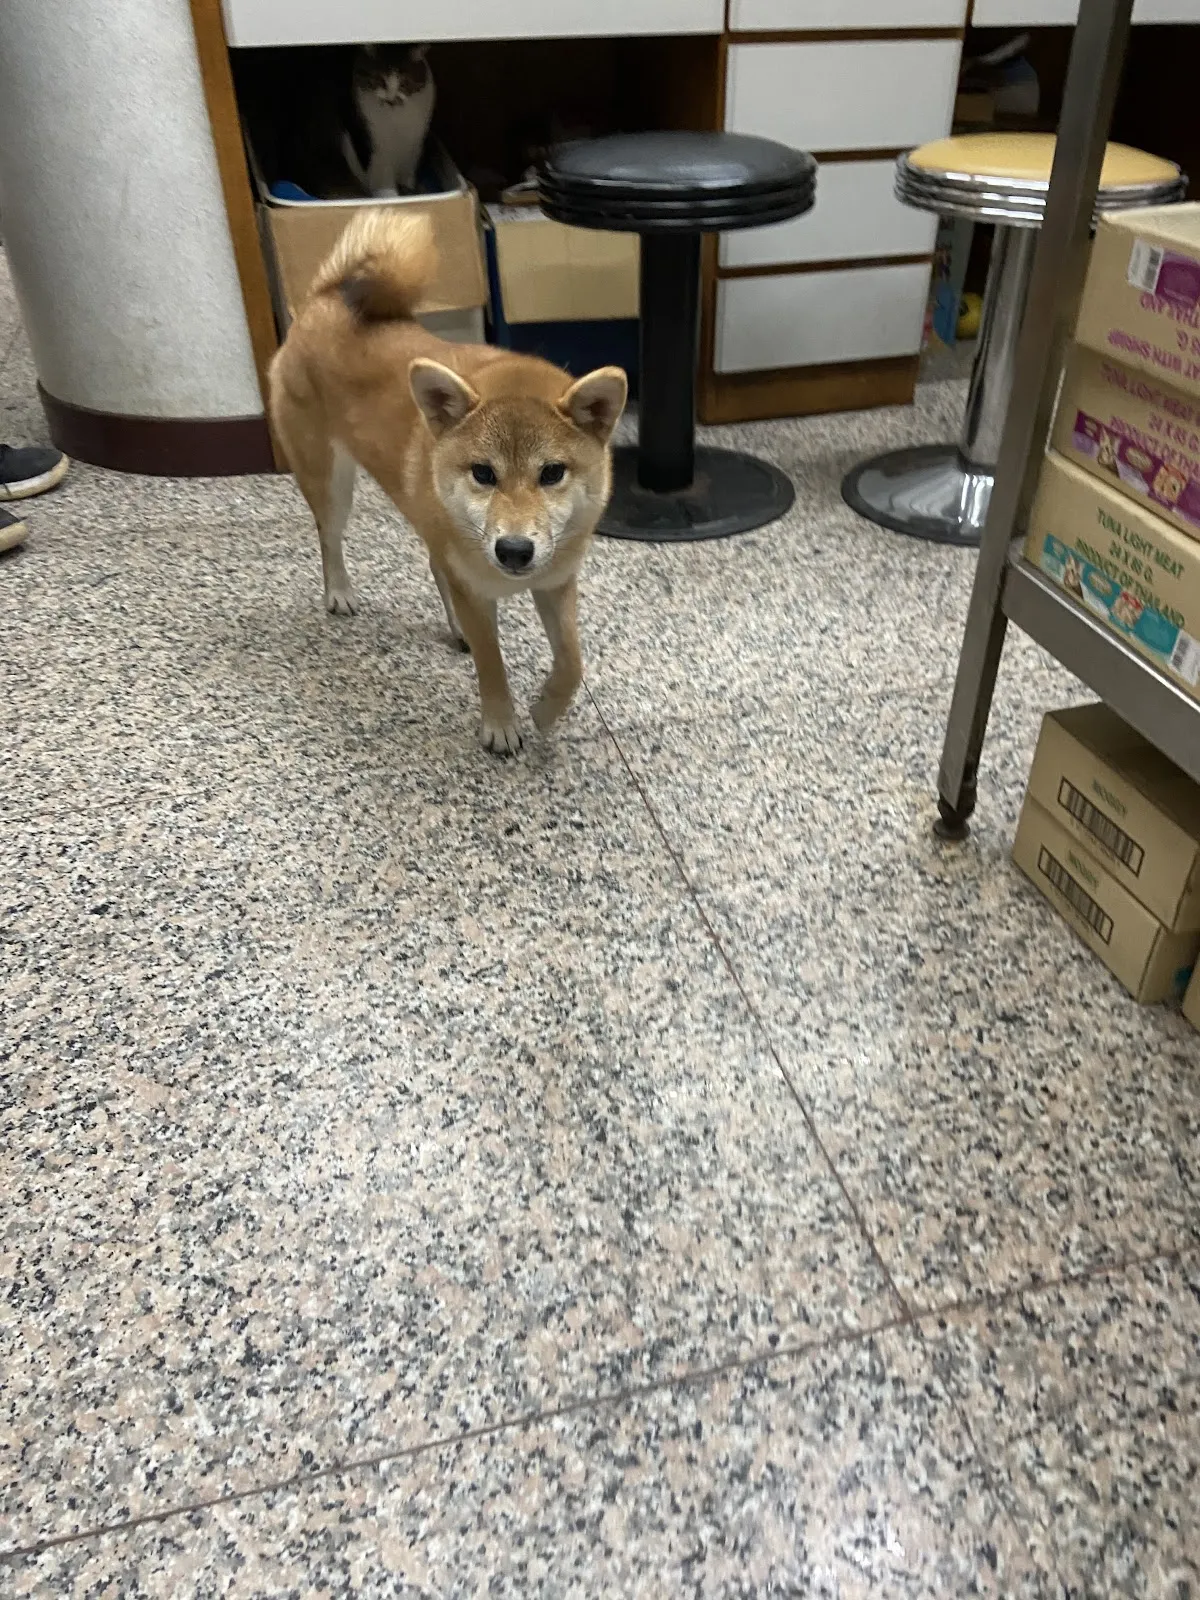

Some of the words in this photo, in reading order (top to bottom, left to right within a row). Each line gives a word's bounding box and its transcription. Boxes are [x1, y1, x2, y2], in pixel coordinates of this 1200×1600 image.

[1097, 508, 1121, 536] TUNA
[1123, 527, 1152, 558] LIGHT
[1155, 548, 1184, 580] MEAT
[1109, 540, 1121, 560] 24
[1144, 564, 1153, 584] G
[1075, 538, 1118, 579] PRODUCT
[1120, 569, 1132, 590] OF
[1134, 582, 1184, 628] THAILAND
